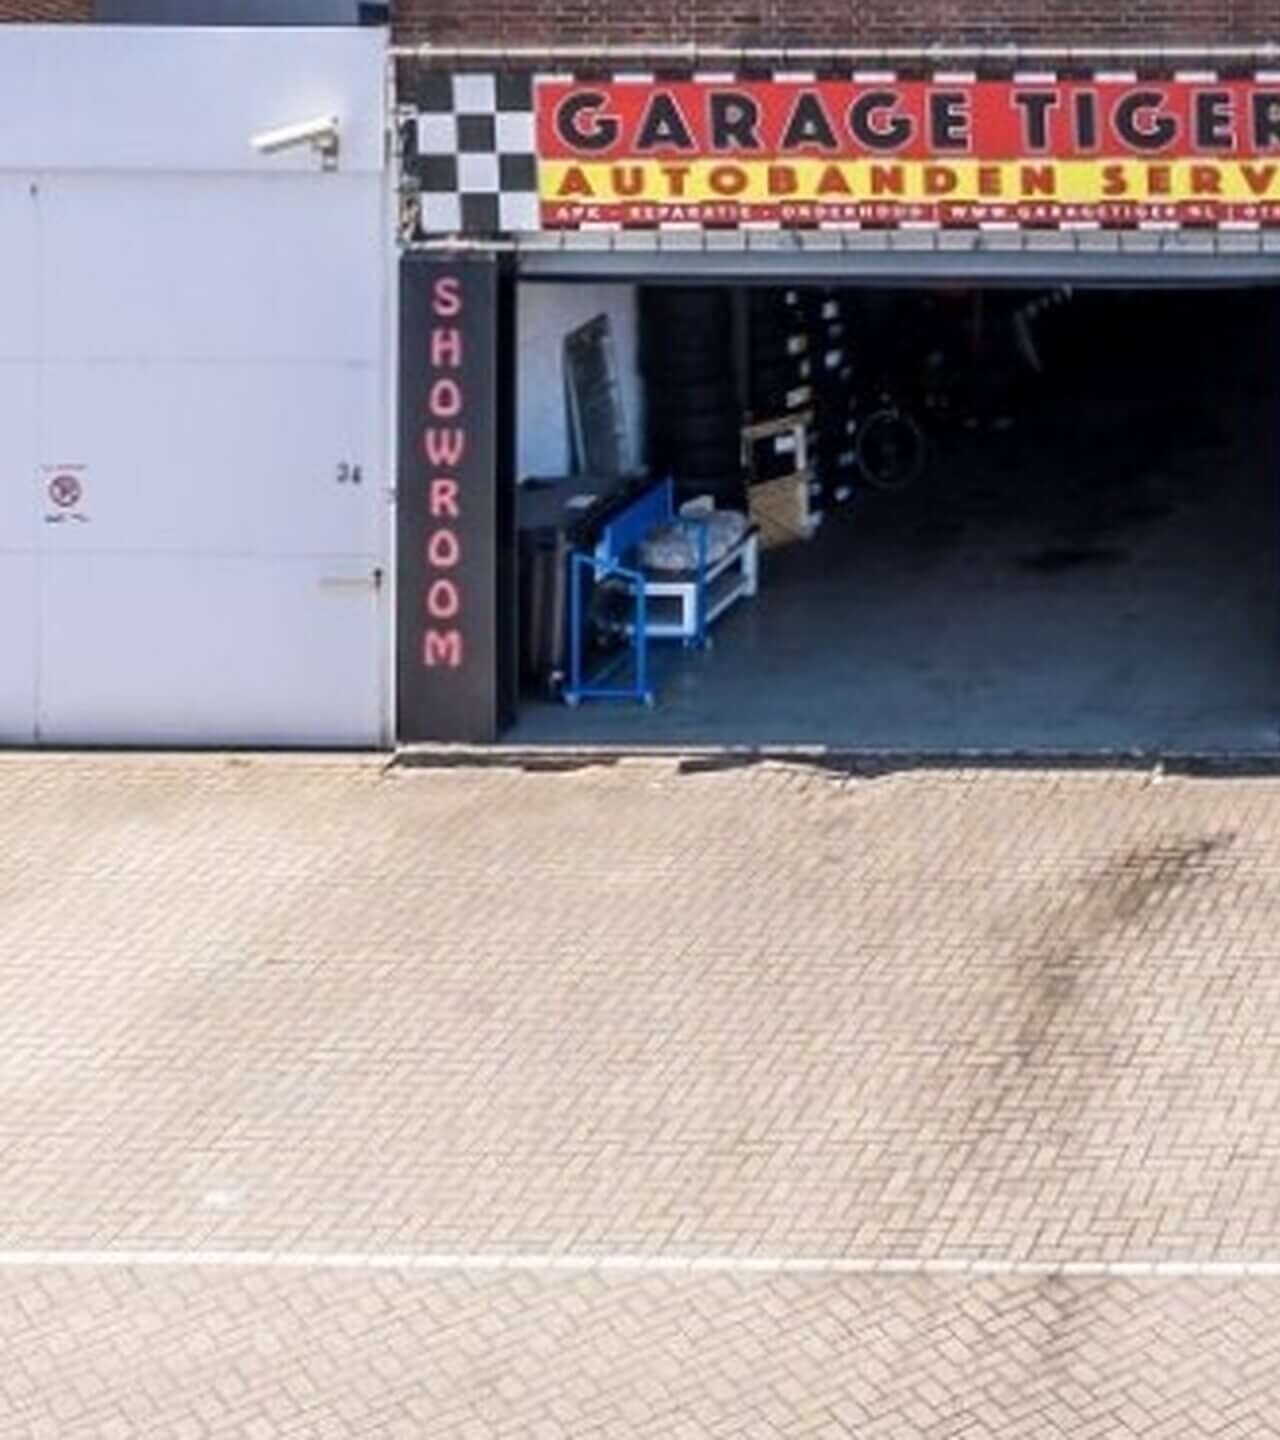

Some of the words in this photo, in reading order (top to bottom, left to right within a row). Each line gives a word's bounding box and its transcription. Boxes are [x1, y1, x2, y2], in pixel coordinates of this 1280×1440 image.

[553, 90, 973, 153] GARAGE
[556, 165, 1057, 196] AUTOBANDEN
[423, 277, 465, 668] SHOWROOM
